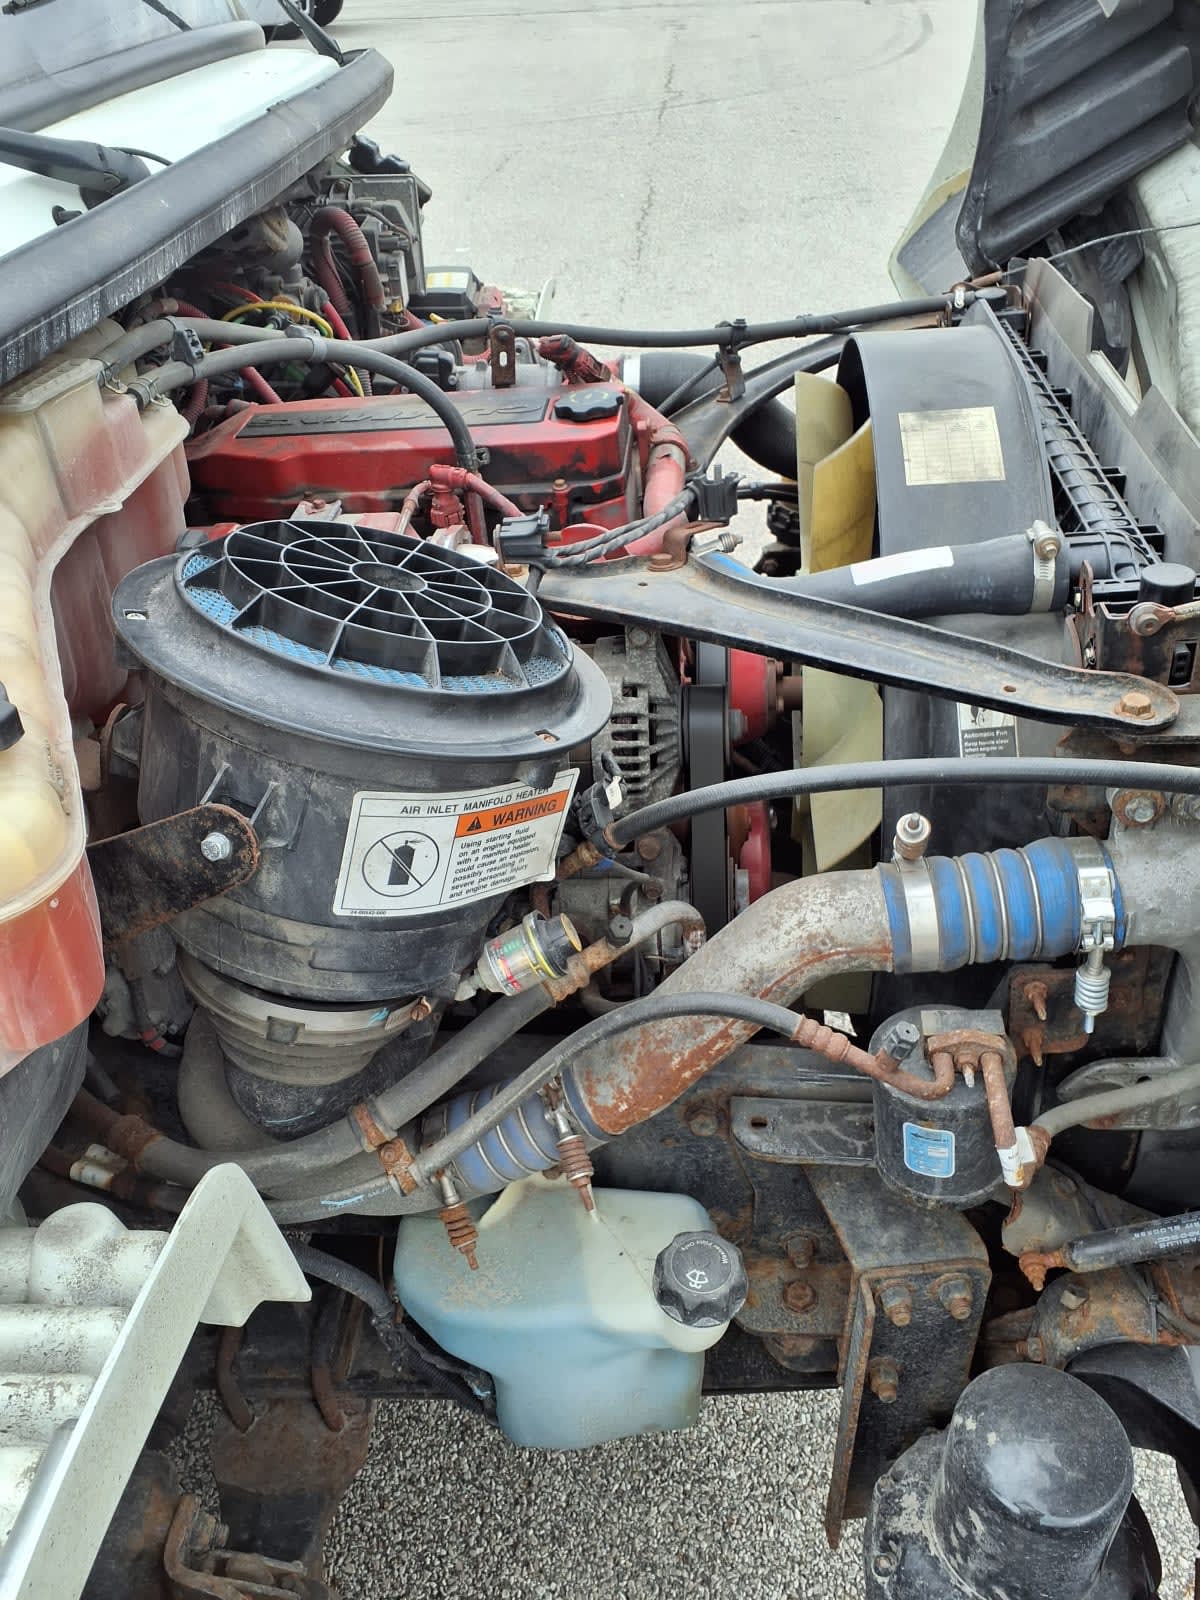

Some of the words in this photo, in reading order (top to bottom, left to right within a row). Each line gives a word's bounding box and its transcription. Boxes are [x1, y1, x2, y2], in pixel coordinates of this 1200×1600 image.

[400, 805, 421, 815] AIR
[426, 804, 458, 814] INLET
[463, 794, 512, 812] MANIFOLD
[515, 788, 549, 801] HEATER
[492, 799, 558, 826] WARNING
[458, 850, 469, 858] on
[482, 842, 505, 853] engine
[508, 832, 537, 847] equipped
[460, 840, 482, 850] Using
[485, 832, 512, 844] starting
[515, 826, 530, 835] fluid
[454, 865, 475, 875] could
[476, 859, 497, 869] cause
[509, 846, 540, 860] explosion,
[456, 855, 472, 866] with
[481, 847, 510, 860] manifold
[513, 842, 532, 852] heater
[450, 880, 475, 891] severe
[478, 871, 508, 883] personal
[510, 863, 529, 874] injury
[452, 871, 484, 884] possibly
[486, 861, 516, 873] resulting
[449, 890, 463, 899] and
[465, 883, 488, 895] engine
